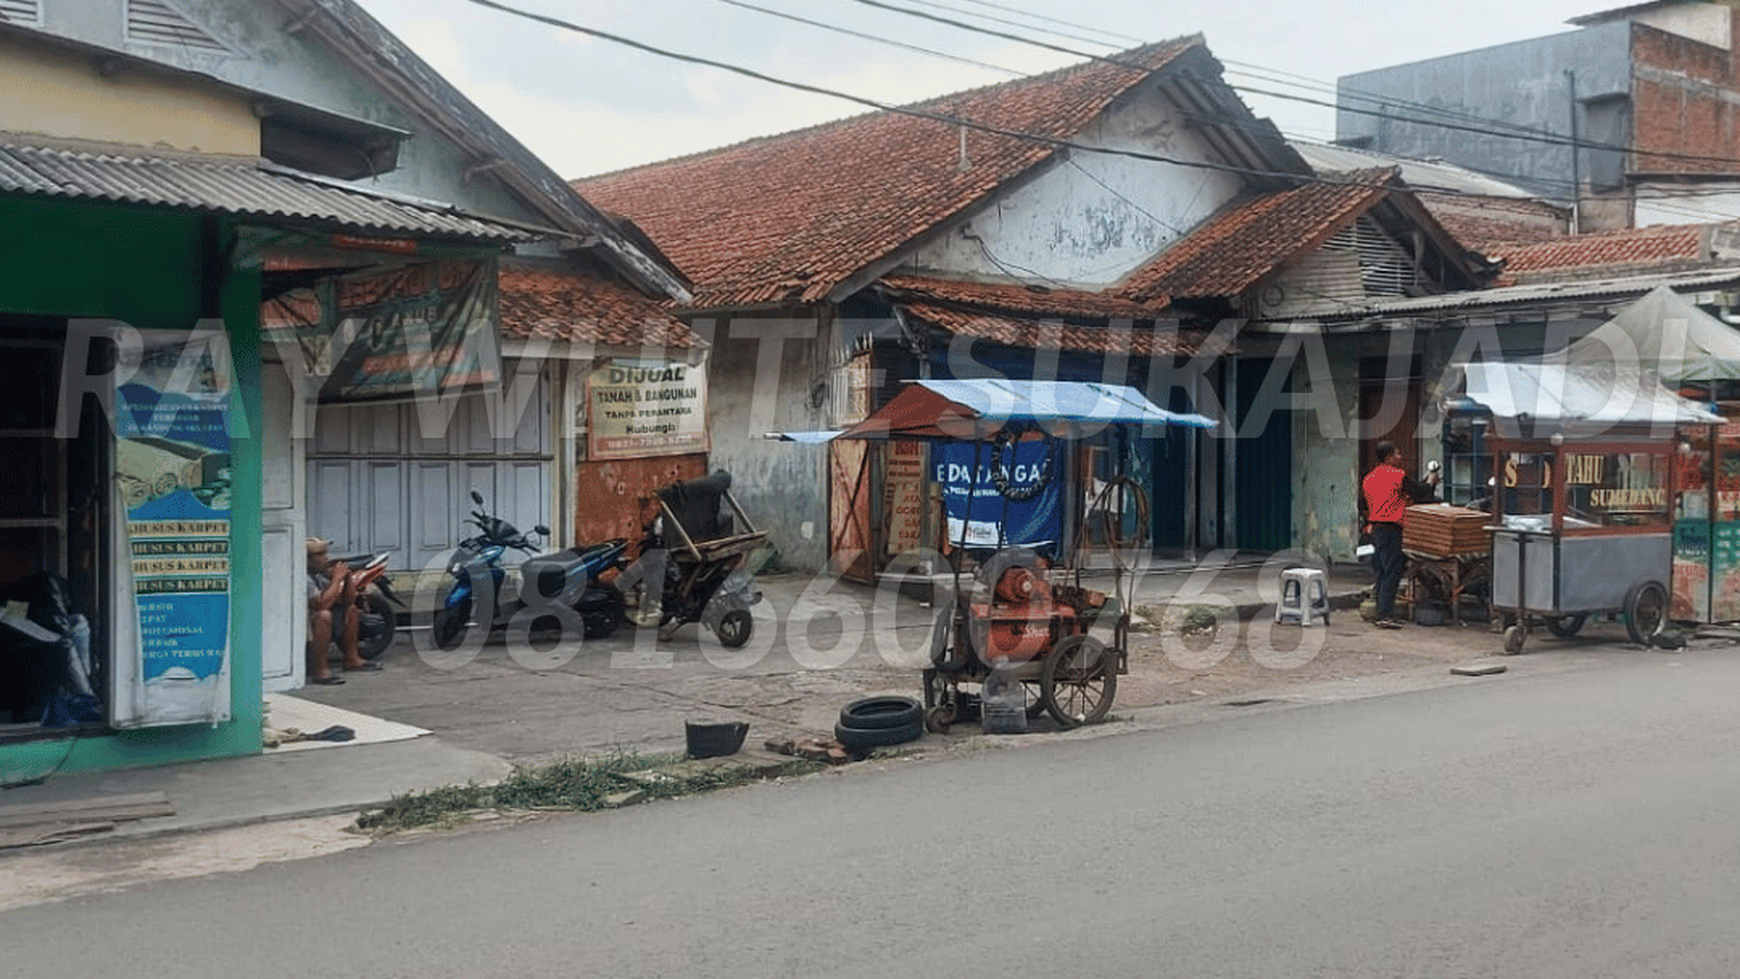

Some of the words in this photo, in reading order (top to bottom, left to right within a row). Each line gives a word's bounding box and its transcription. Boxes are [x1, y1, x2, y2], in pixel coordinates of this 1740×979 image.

[608, 366, 686, 385] DIJUAL
[597, 391, 633, 404] TANAH
[645, 387, 697, 401] BANGUNAN
[1566, 454, 1604, 484] TAHU
[1589, 488, 1666, 507] SUMEDANG
[178, 521, 228, 534] KARPET
[177, 541, 228, 553] KARPET
[177, 560, 228, 571] KARPET
[178, 579, 228, 591] KARPET
